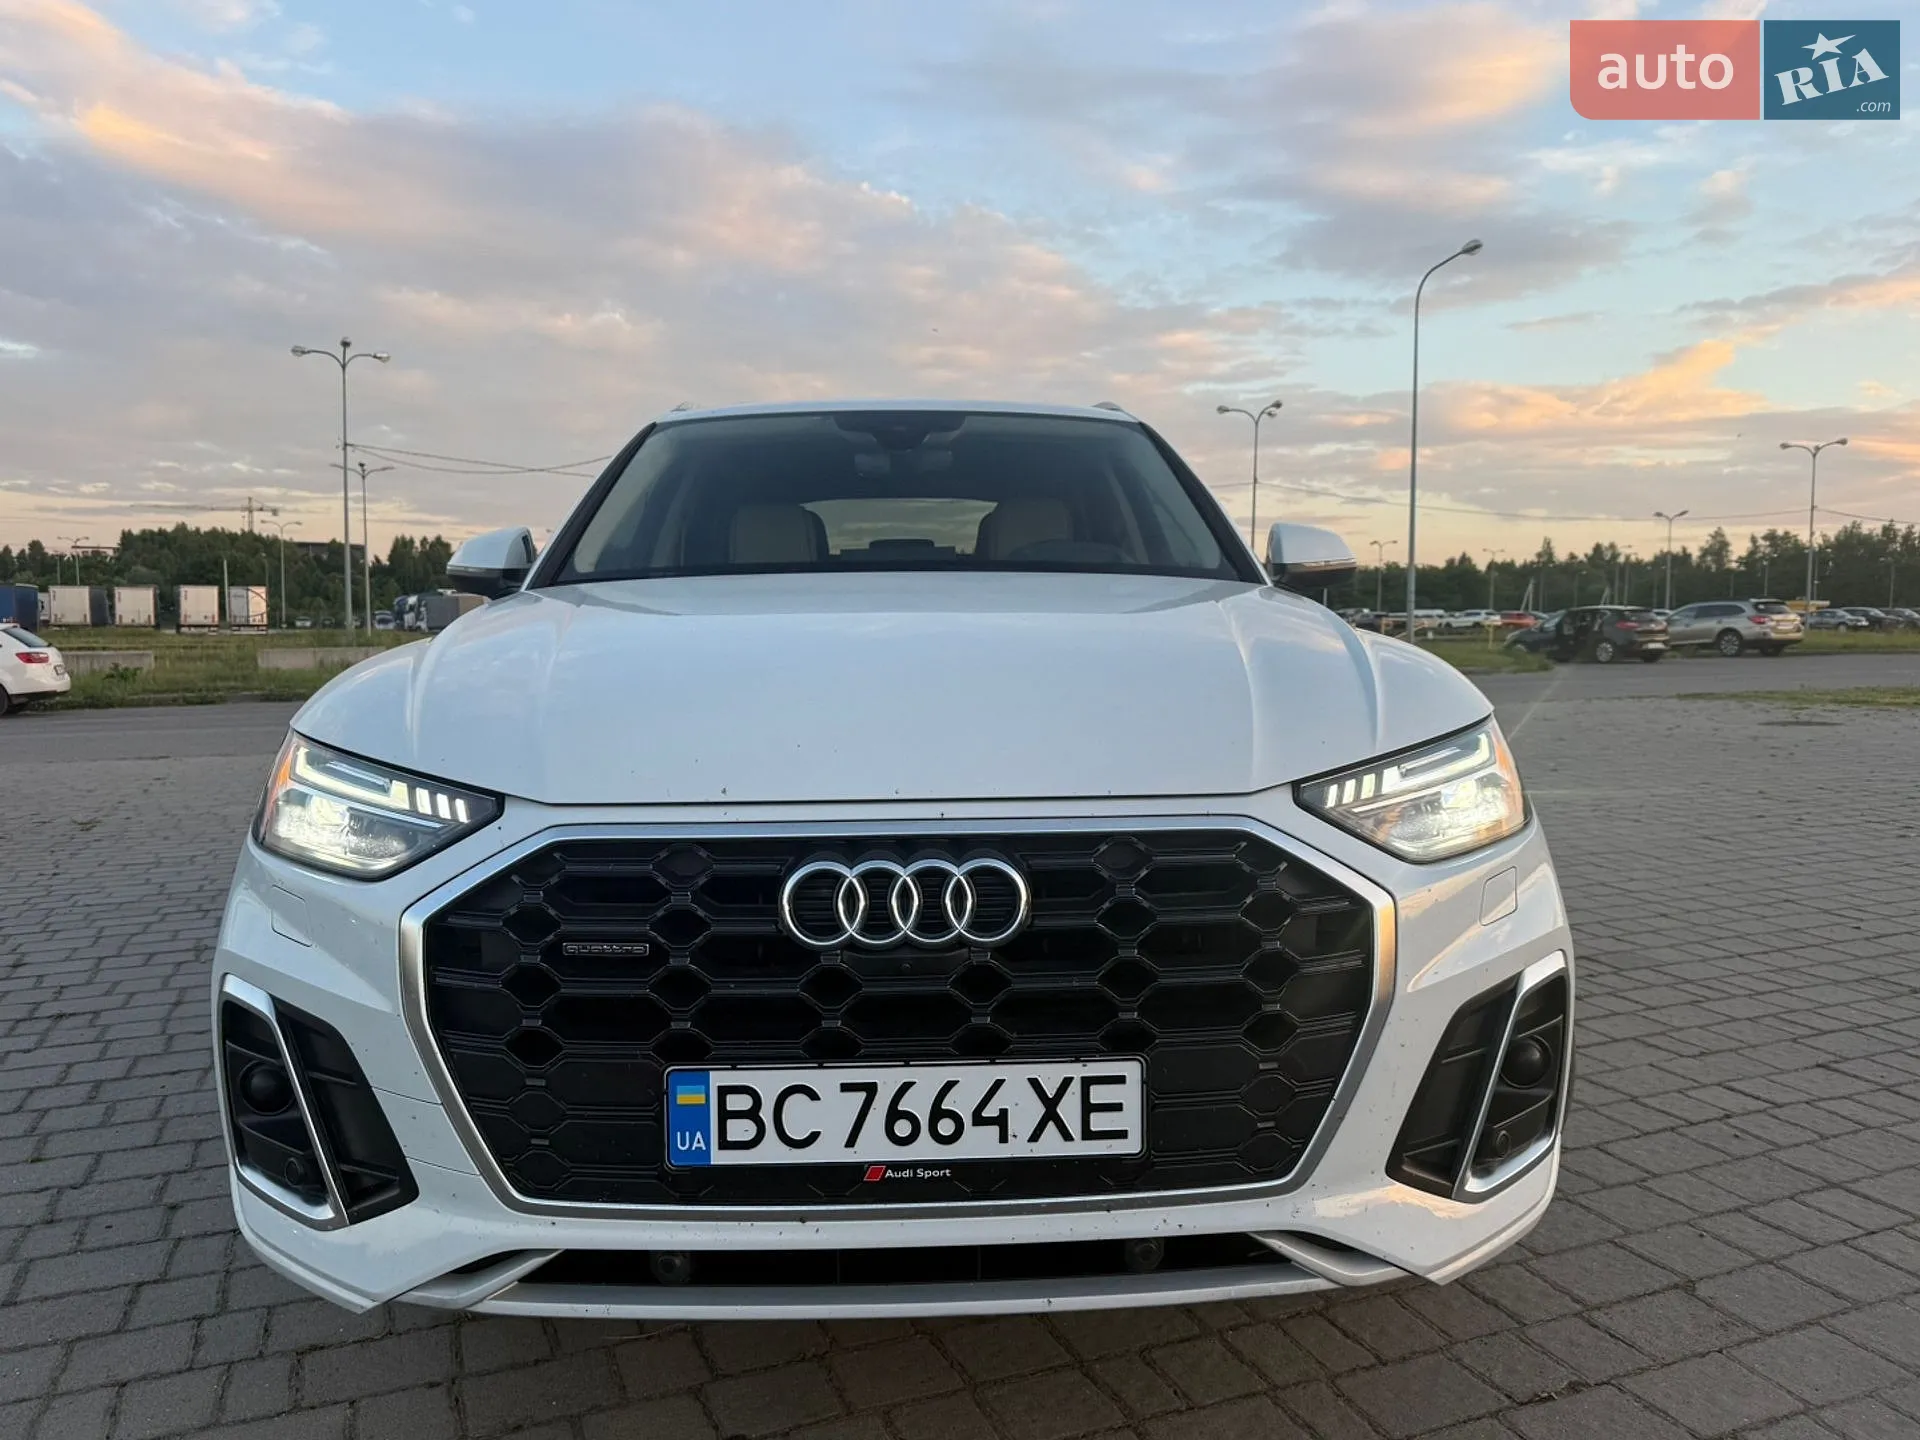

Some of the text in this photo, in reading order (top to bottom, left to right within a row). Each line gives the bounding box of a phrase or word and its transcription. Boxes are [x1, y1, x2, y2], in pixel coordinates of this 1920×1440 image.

[566, 945, 645, 954] quattro
[716, 1074, 1128, 1151] BC 7664 XE
[676, 1131, 706, 1151] UA
[885, 1168, 952, 1179] Audi Sport
